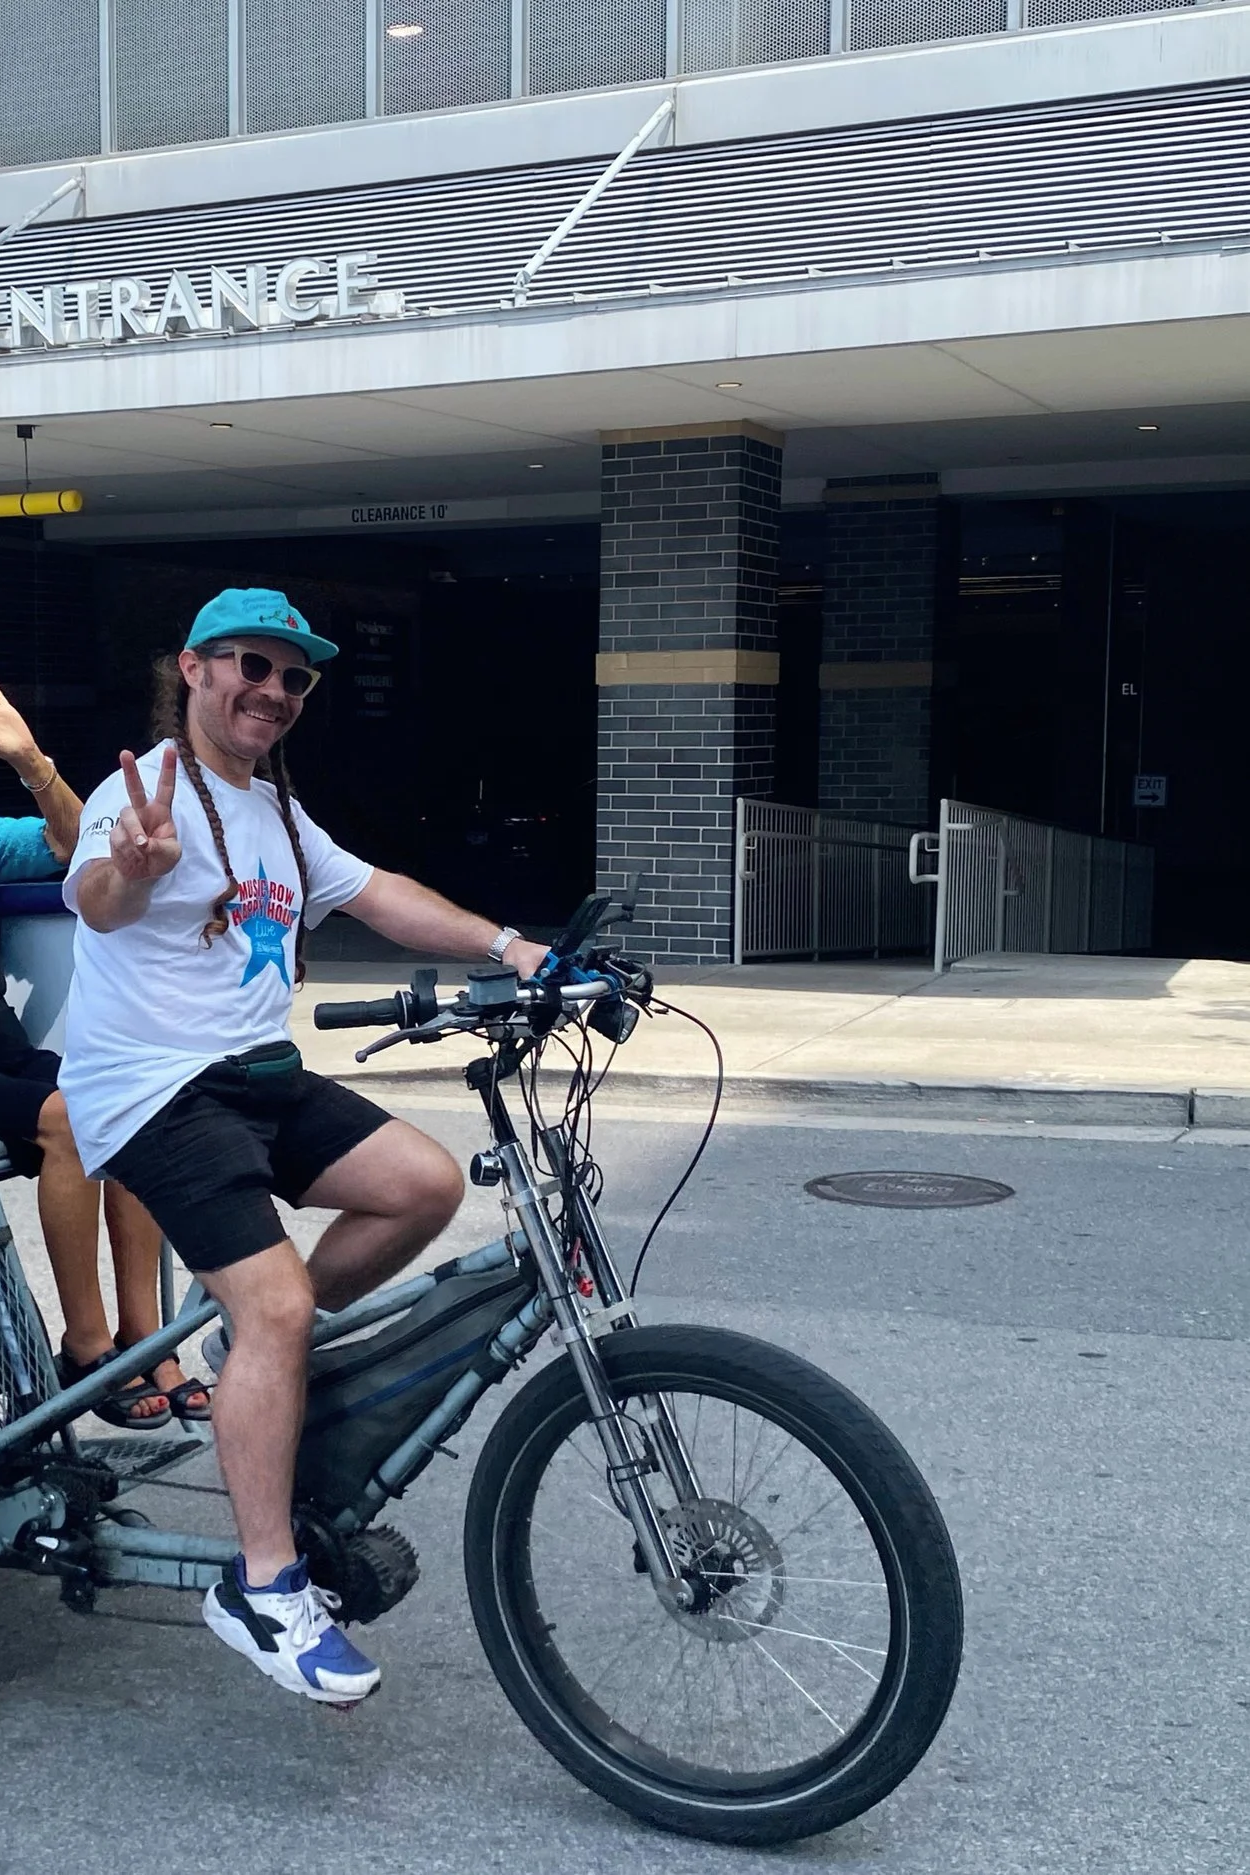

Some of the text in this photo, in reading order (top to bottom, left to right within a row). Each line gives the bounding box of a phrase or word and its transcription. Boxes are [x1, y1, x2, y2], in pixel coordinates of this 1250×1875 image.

[352, 504, 448, 523] CLEARANCE 10'
[1122, 683, 1137, 695] EL
[1137, 778, 1165, 790] EXIT
[81, 816, 121, 841] min
[238, 878, 295, 907] MUSIC ROW
[231, 899, 267, 927] HAPPY
[255, 920, 276, 938] Live
